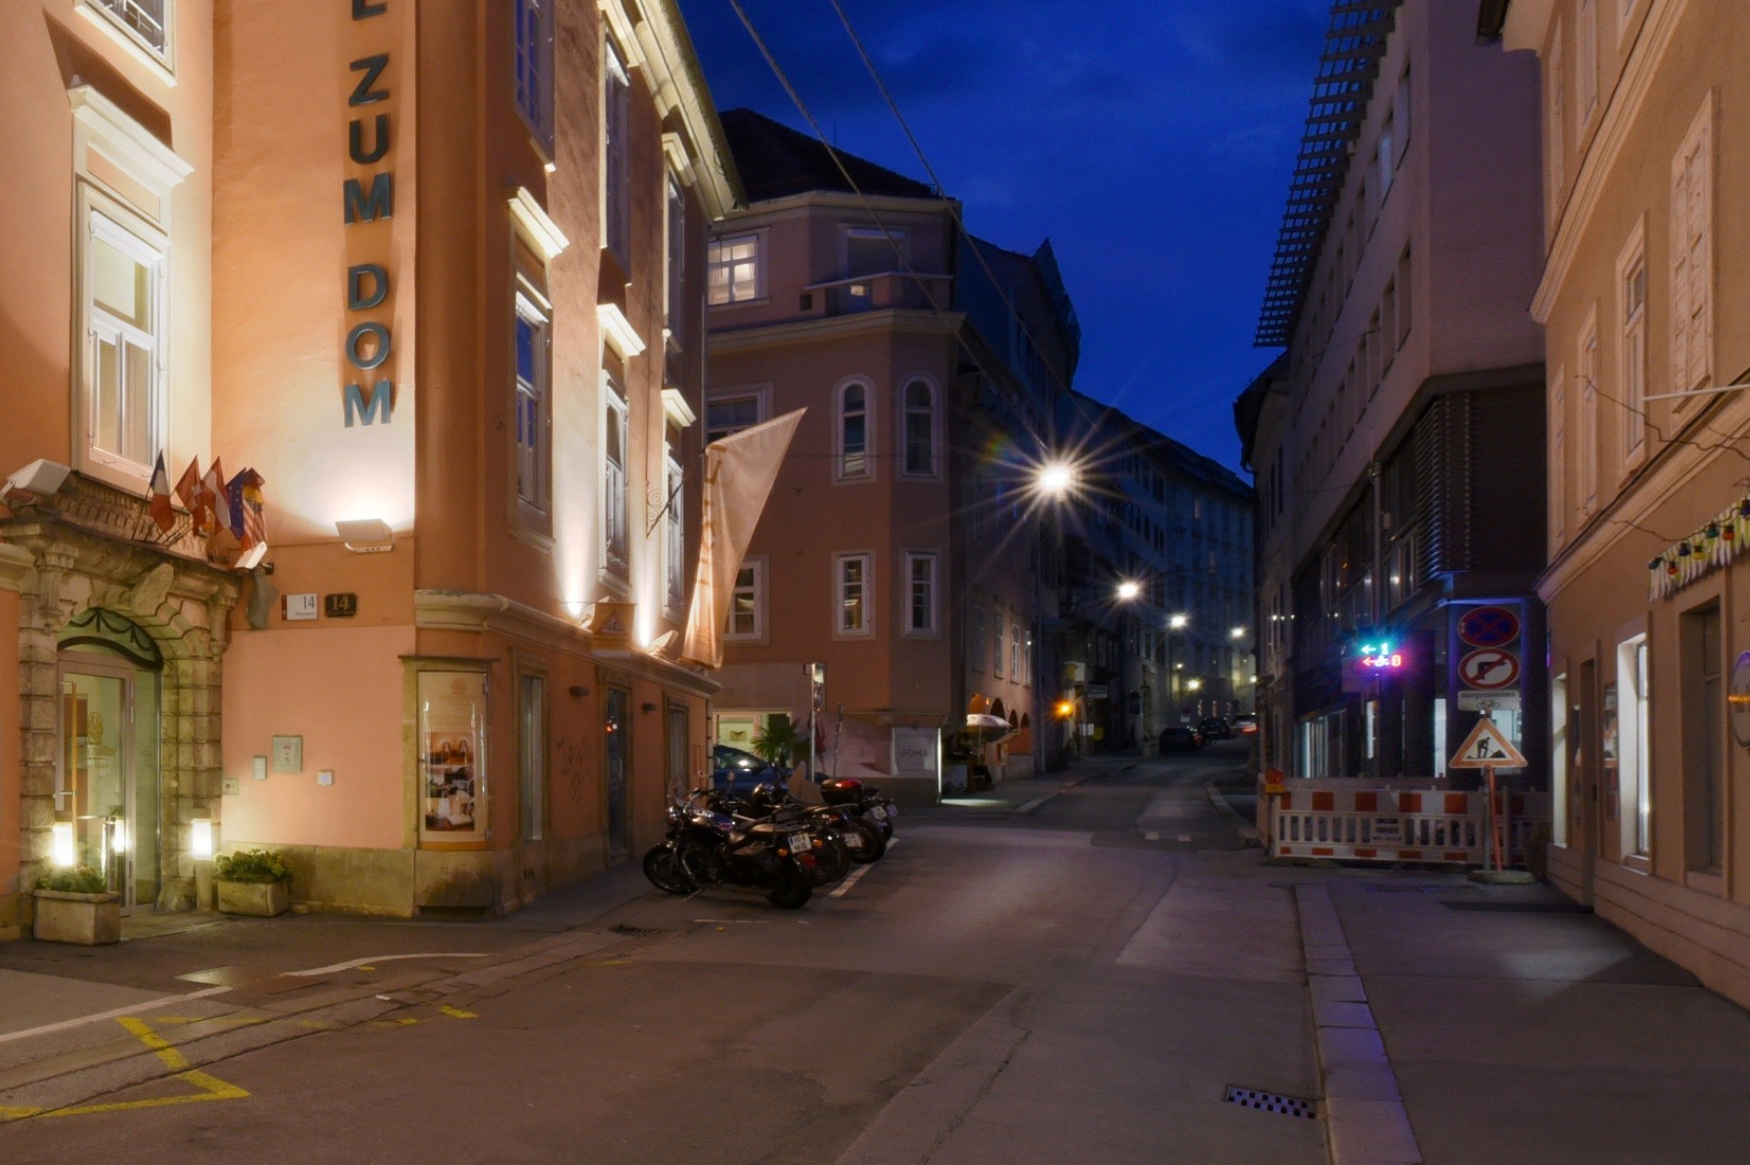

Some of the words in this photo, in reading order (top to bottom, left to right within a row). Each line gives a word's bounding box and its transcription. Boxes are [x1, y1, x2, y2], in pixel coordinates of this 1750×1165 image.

[343, 53, 392, 225] ZUM
[344, 264, 391, 428] DOM
[303, 596, 315, 609] 14
[332, 595, 350, 610] 14
